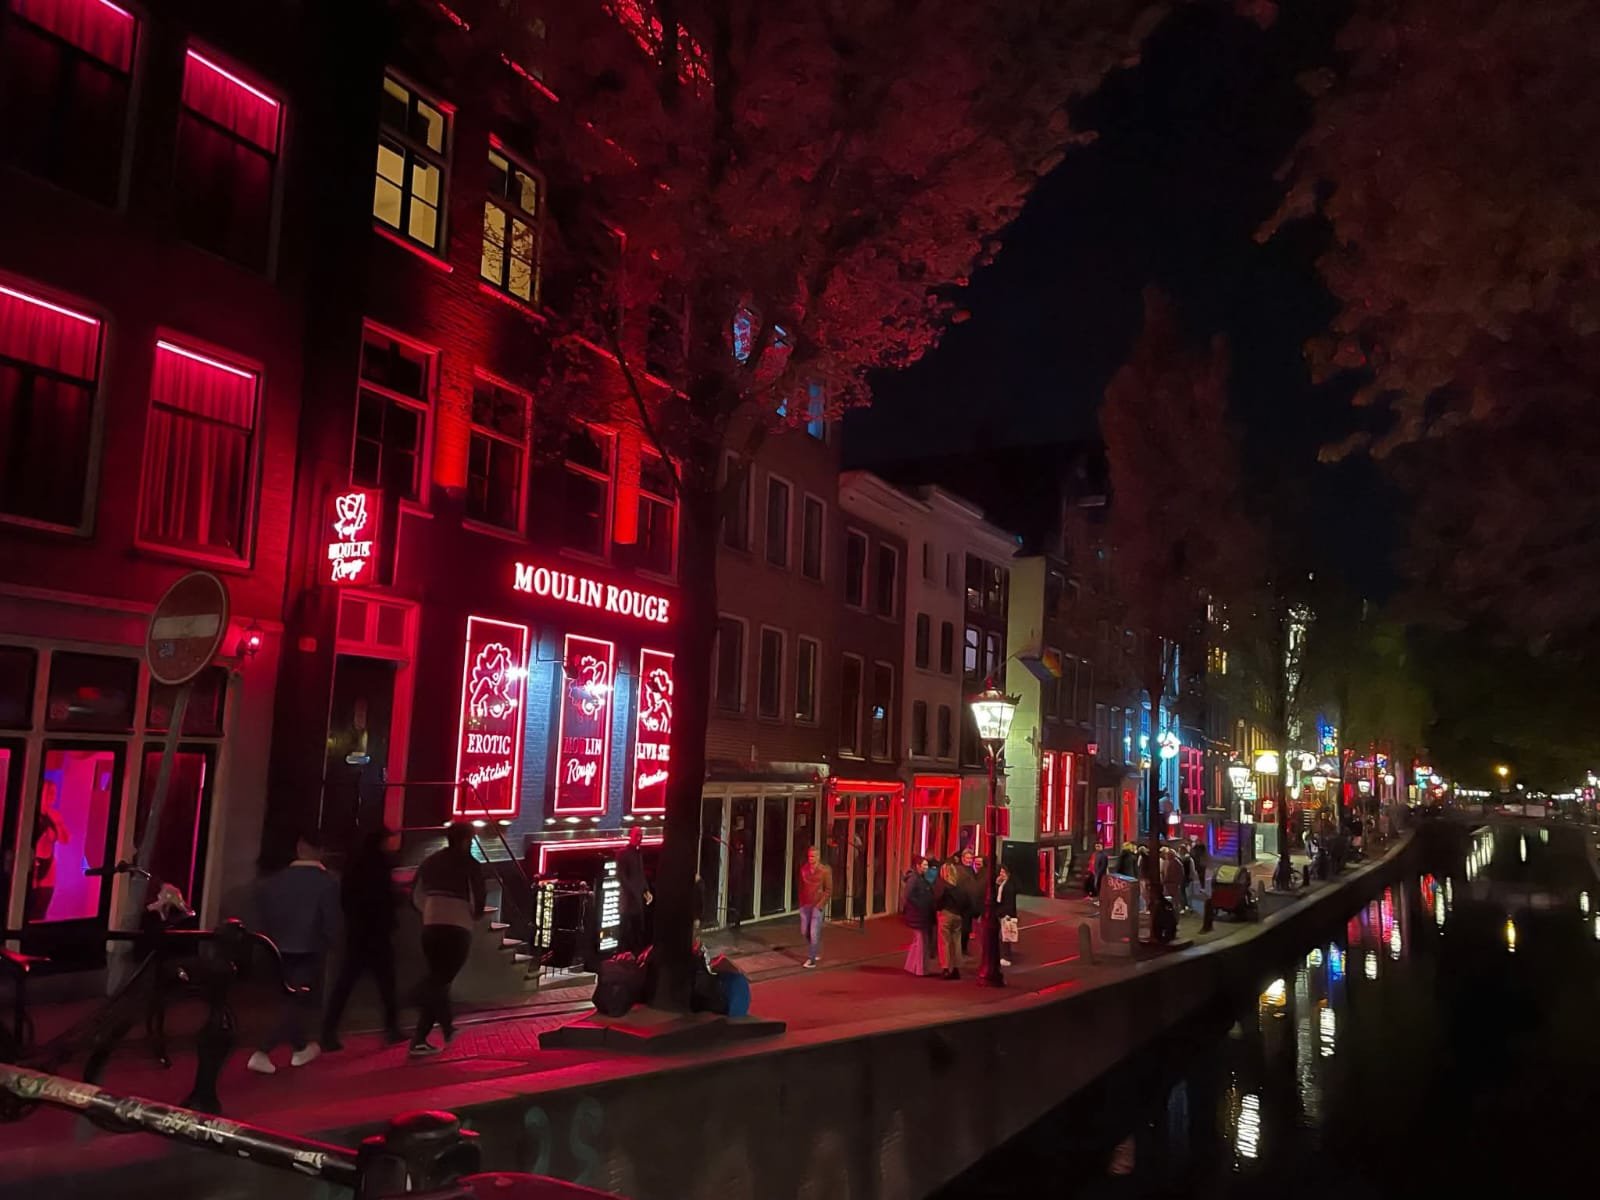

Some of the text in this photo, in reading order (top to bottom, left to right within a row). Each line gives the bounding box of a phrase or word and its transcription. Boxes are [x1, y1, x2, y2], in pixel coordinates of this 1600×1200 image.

[513, 562, 670, 624] MOULIN ROUGE
[466, 733, 511, 755] EROTIC
[463, 760, 512, 789] ightclub
